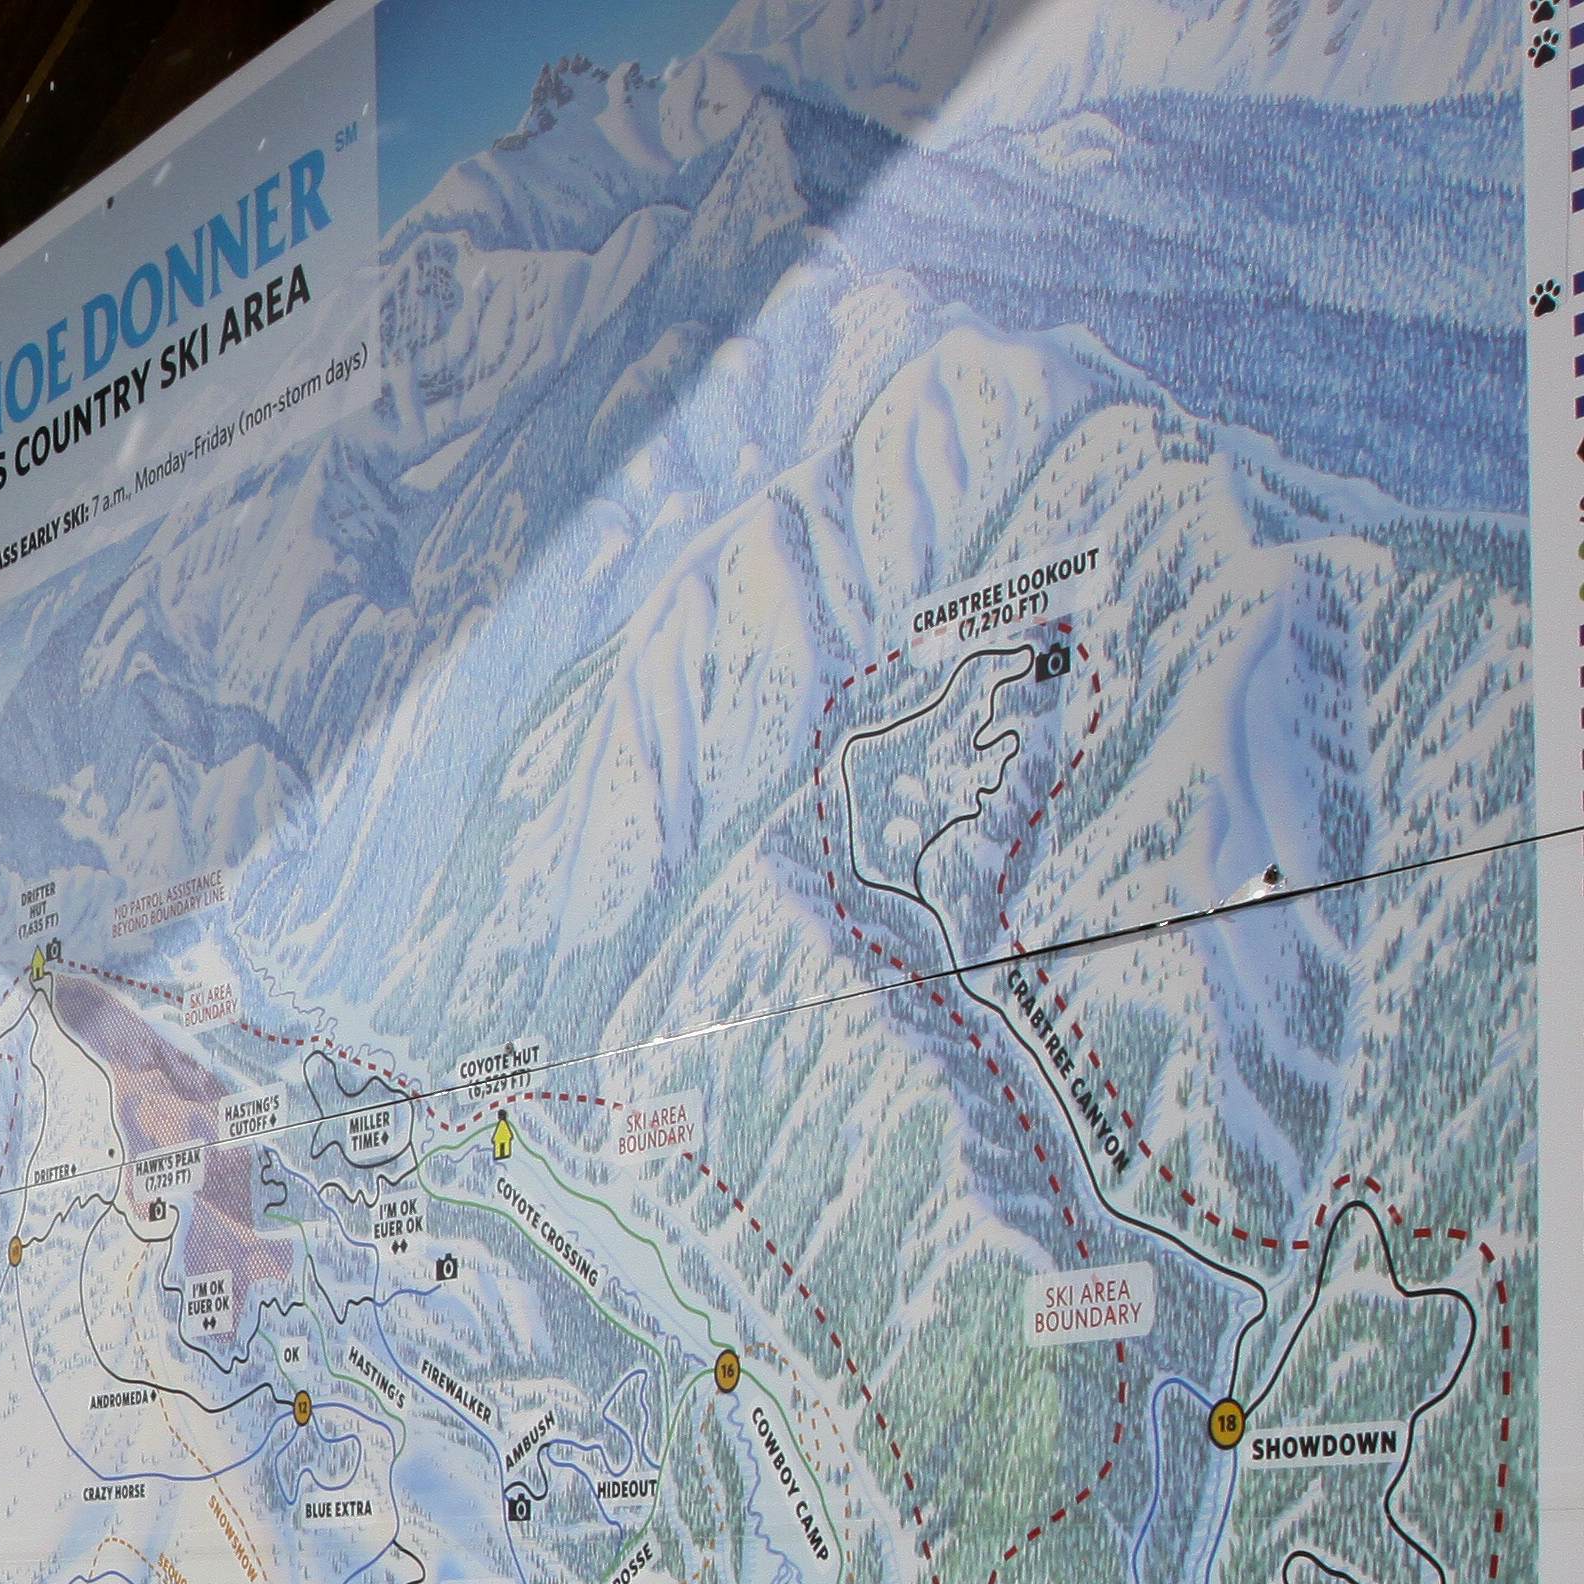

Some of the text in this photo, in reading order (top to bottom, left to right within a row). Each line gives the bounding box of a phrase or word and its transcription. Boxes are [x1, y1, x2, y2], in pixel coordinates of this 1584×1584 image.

[81, 149, 332, 381] DONNER
[14, 358, 152, 477] COUNTRY
[160, 322, 209, 390] SKI
[218, 263, 311, 356] AREA
[20, 520, 61, 557] EARLY
[63, 504, 90, 535] SKI:
[91, 496, 100, 517] 7
[135, 421, 236, 493] Monday-Friday
[238, 374, 322, 436] (non-storm
[325, 341, 369, 386] days)
[913, 547, 1100, 634] CRABTREE LOOKOUT
[958, 590, 1049, 642] (7,270 FT)
[21, 882, 56, 907] DRIFTER
[459, 1045, 540, 1079] COYOTE HUT
[1007, 968, 1130, 1175] CRABTREE CANYON
[225, 1094, 279, 1122] HASTING'S
[626, 1104, 687, 1133] SKI AREA
[229, 1113, 269, 1136] CUTOFF
[349, 1111, 390, 1135] MILLER
[351, 1131, 380, 1153] TIME
[618, 1123, 694, 1155] BOUNDARY
[136, 1149, 201, 1177] HAWK'S PEAK
[496, 1177, 599, 1288] COYOTE CROSSING
[1045, 1279, 1132, 1308] SKI AREA
[1034, 1303, 1143, 1334] BOUNDARY
[284, 1347, 300, 1363] OK
[720, 1364, 735, 1378] 16
[90, 1391, 148, 1409] ANDROMEDA
[421, 1359, 492, 1425] FIREWALKER
[1217, 1414, 1238, 1434] 18
[505, 1410, 556, 1472] AMBUSH
[1252, 1431, 1398, 1461] SHOWDOWN
[597, 1479, 658, 1499] HIDEOUT
[751, 1407, 830, 1562] COWBOY CAMP
[305, 1500, 373, 1518] BLUE EXTRA
